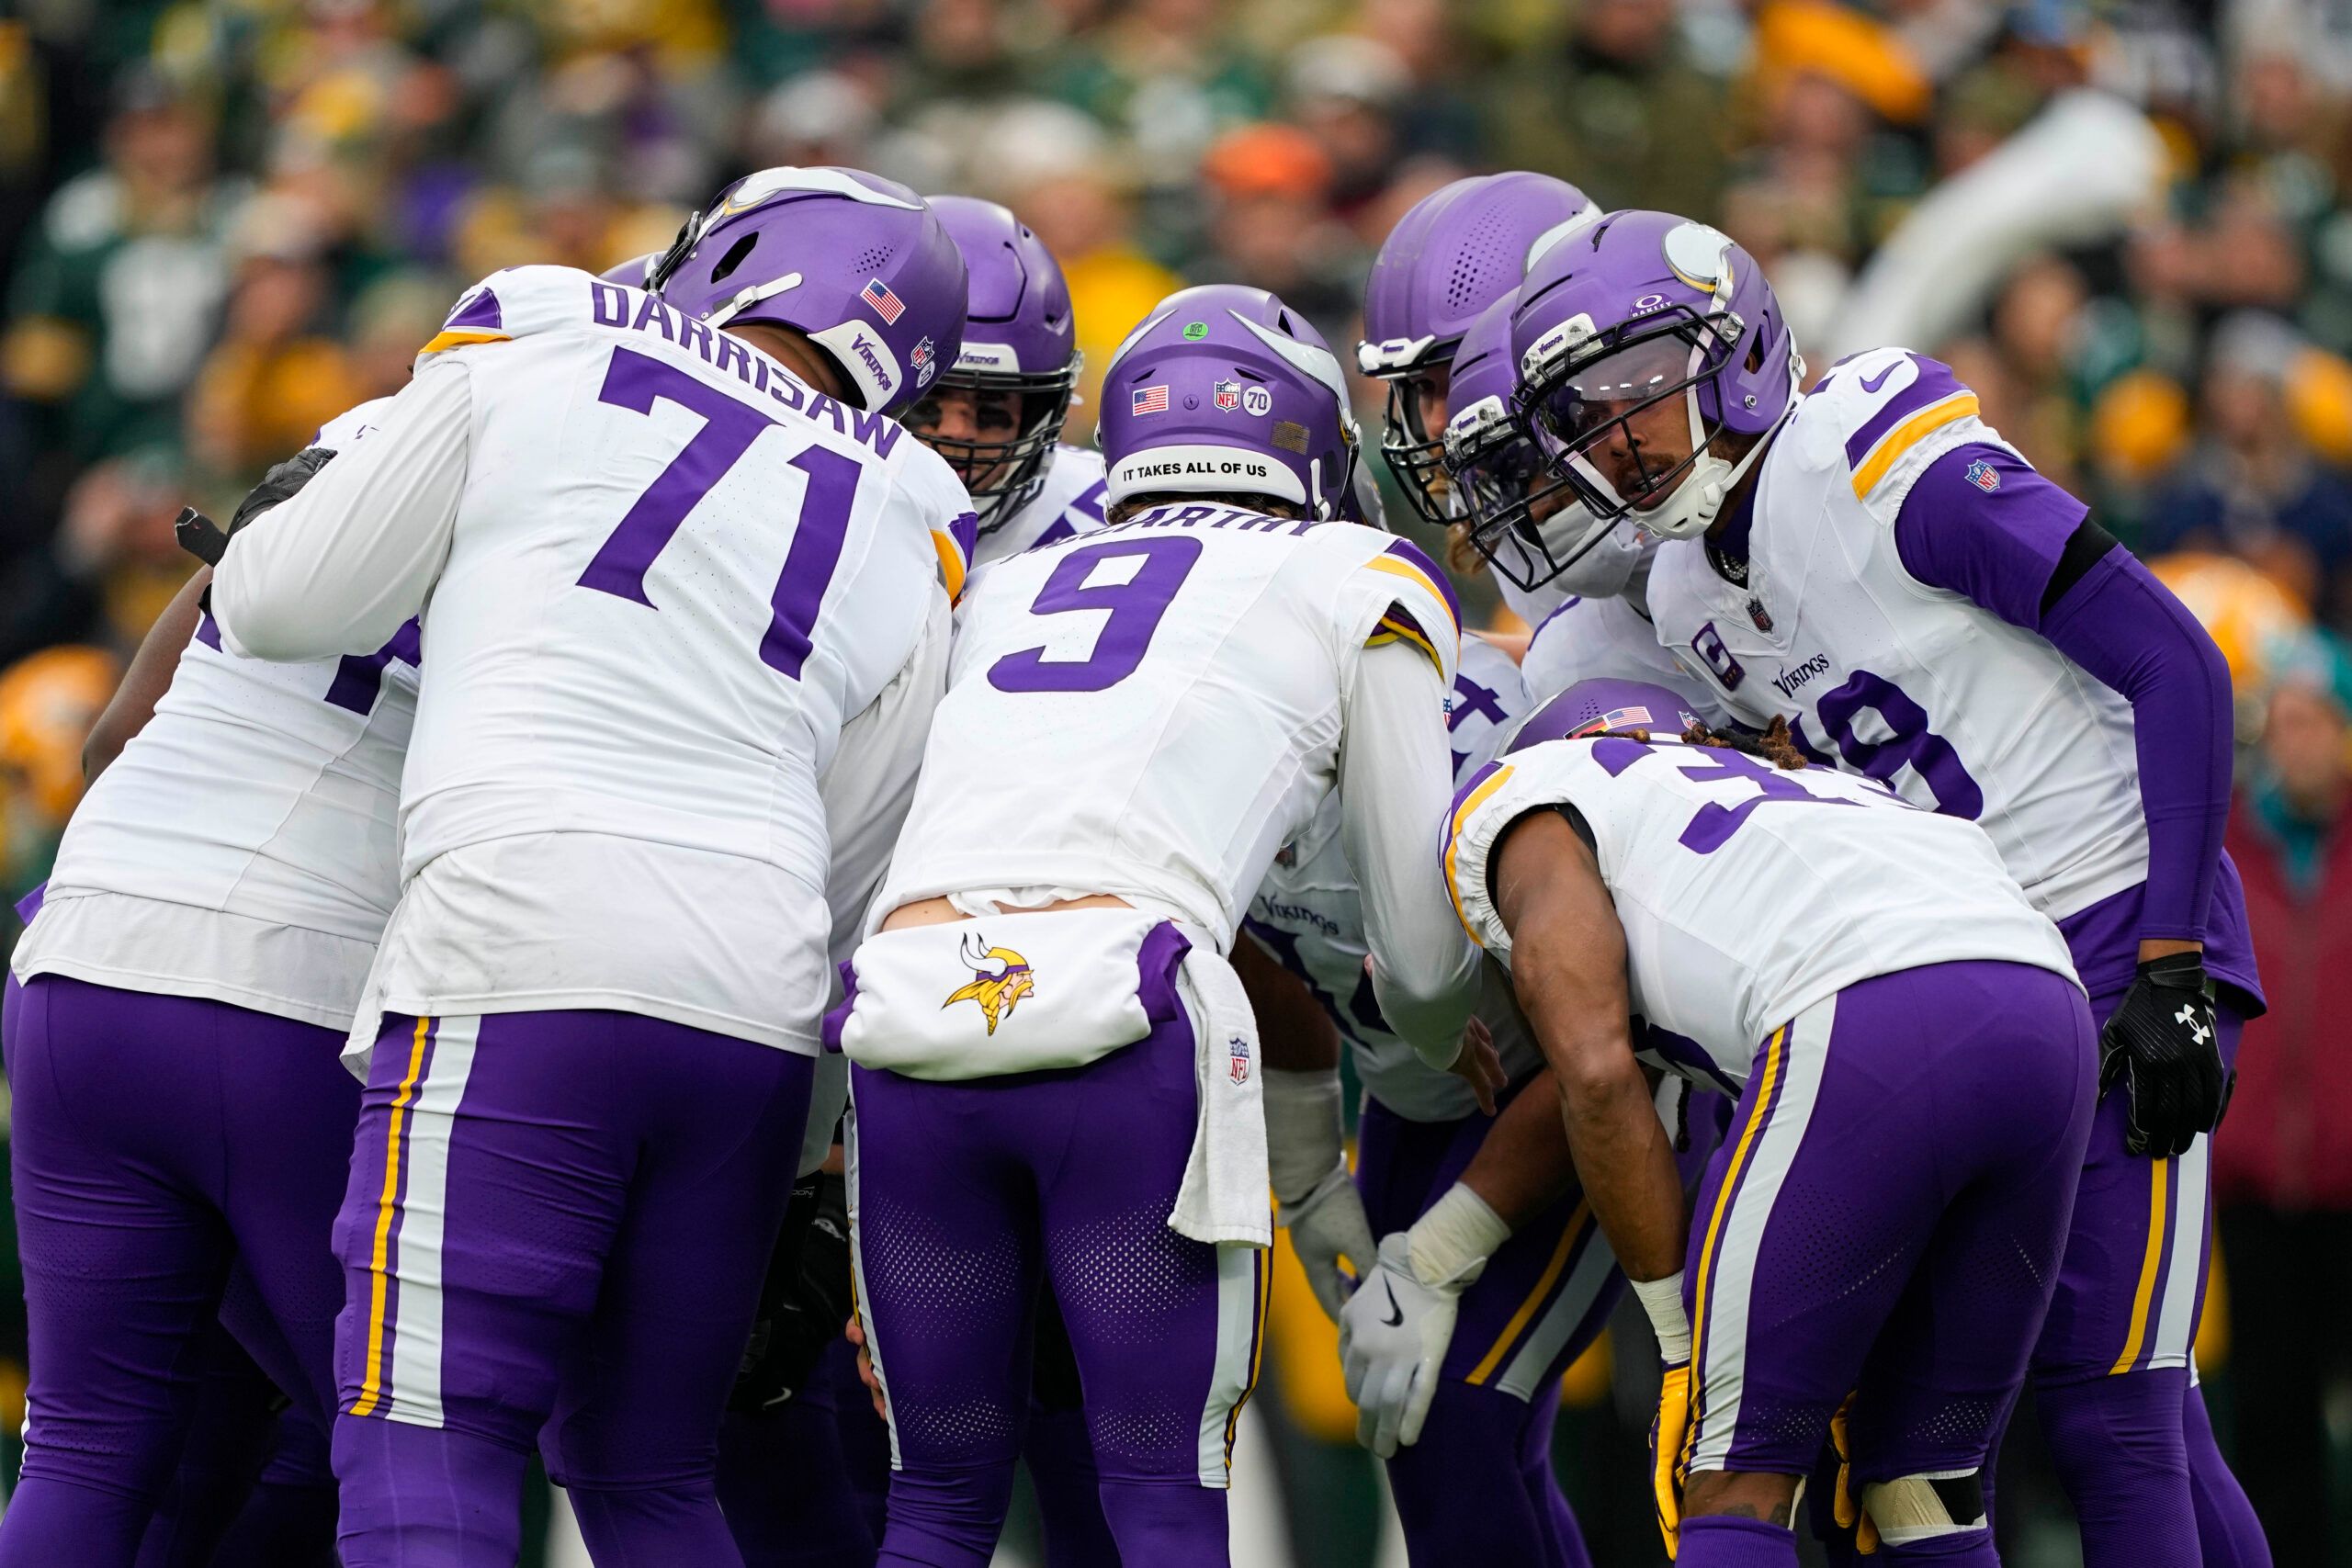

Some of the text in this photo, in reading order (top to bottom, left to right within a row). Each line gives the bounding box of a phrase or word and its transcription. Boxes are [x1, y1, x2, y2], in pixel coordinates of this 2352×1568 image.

[1632, 301, 1672, 318] OAKLEY
[591, 281, 903, 460] DARRISAW
[1217, 391, 1238, 407] NFL
[1248, 391, 1268, 411] 70
[1124, 462, 1267, 481] IT TAKES ALL OF US
[576, 344, 863, 682] 71
[987, 536, 1204, 693] 9
[1697, 630, 1731, 676] C
